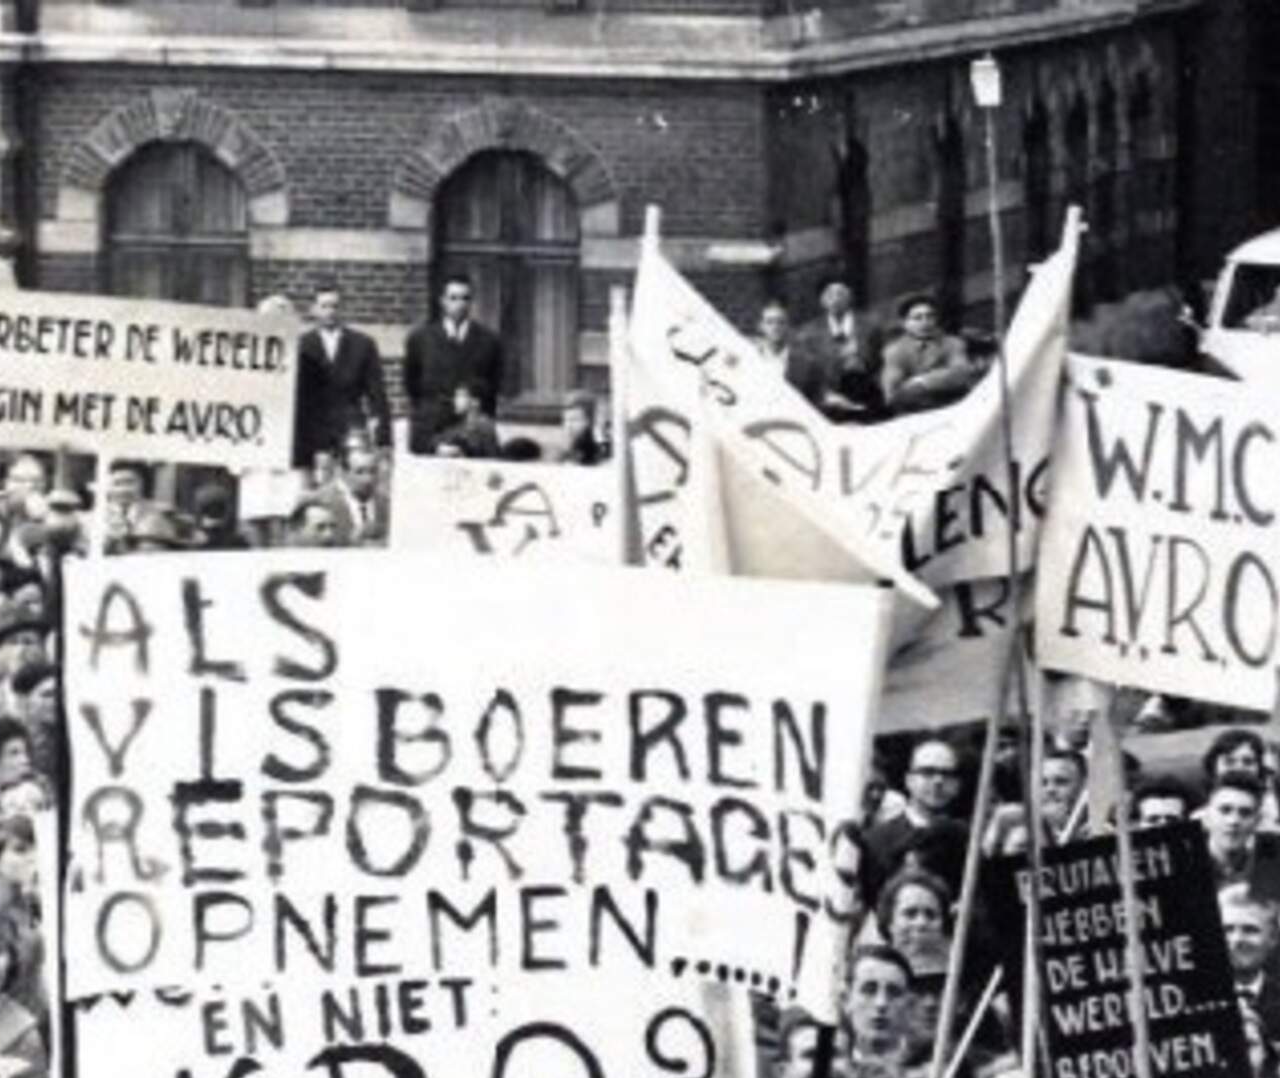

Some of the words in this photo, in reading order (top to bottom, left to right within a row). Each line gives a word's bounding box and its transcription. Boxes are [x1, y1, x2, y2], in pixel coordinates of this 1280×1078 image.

[124, 323, 160, 363] DE
[52, 392, 115, 431] MET
[124, 396, 160, 434] DE
[79, 572, 339, 682] ALS
[80, 780, 864, 925] REPORTAGES
[1046, 955, 1089, 993] DE
[1093, 935, 1195, 984] HLVE
[200, 995, 284, 1055] EN
